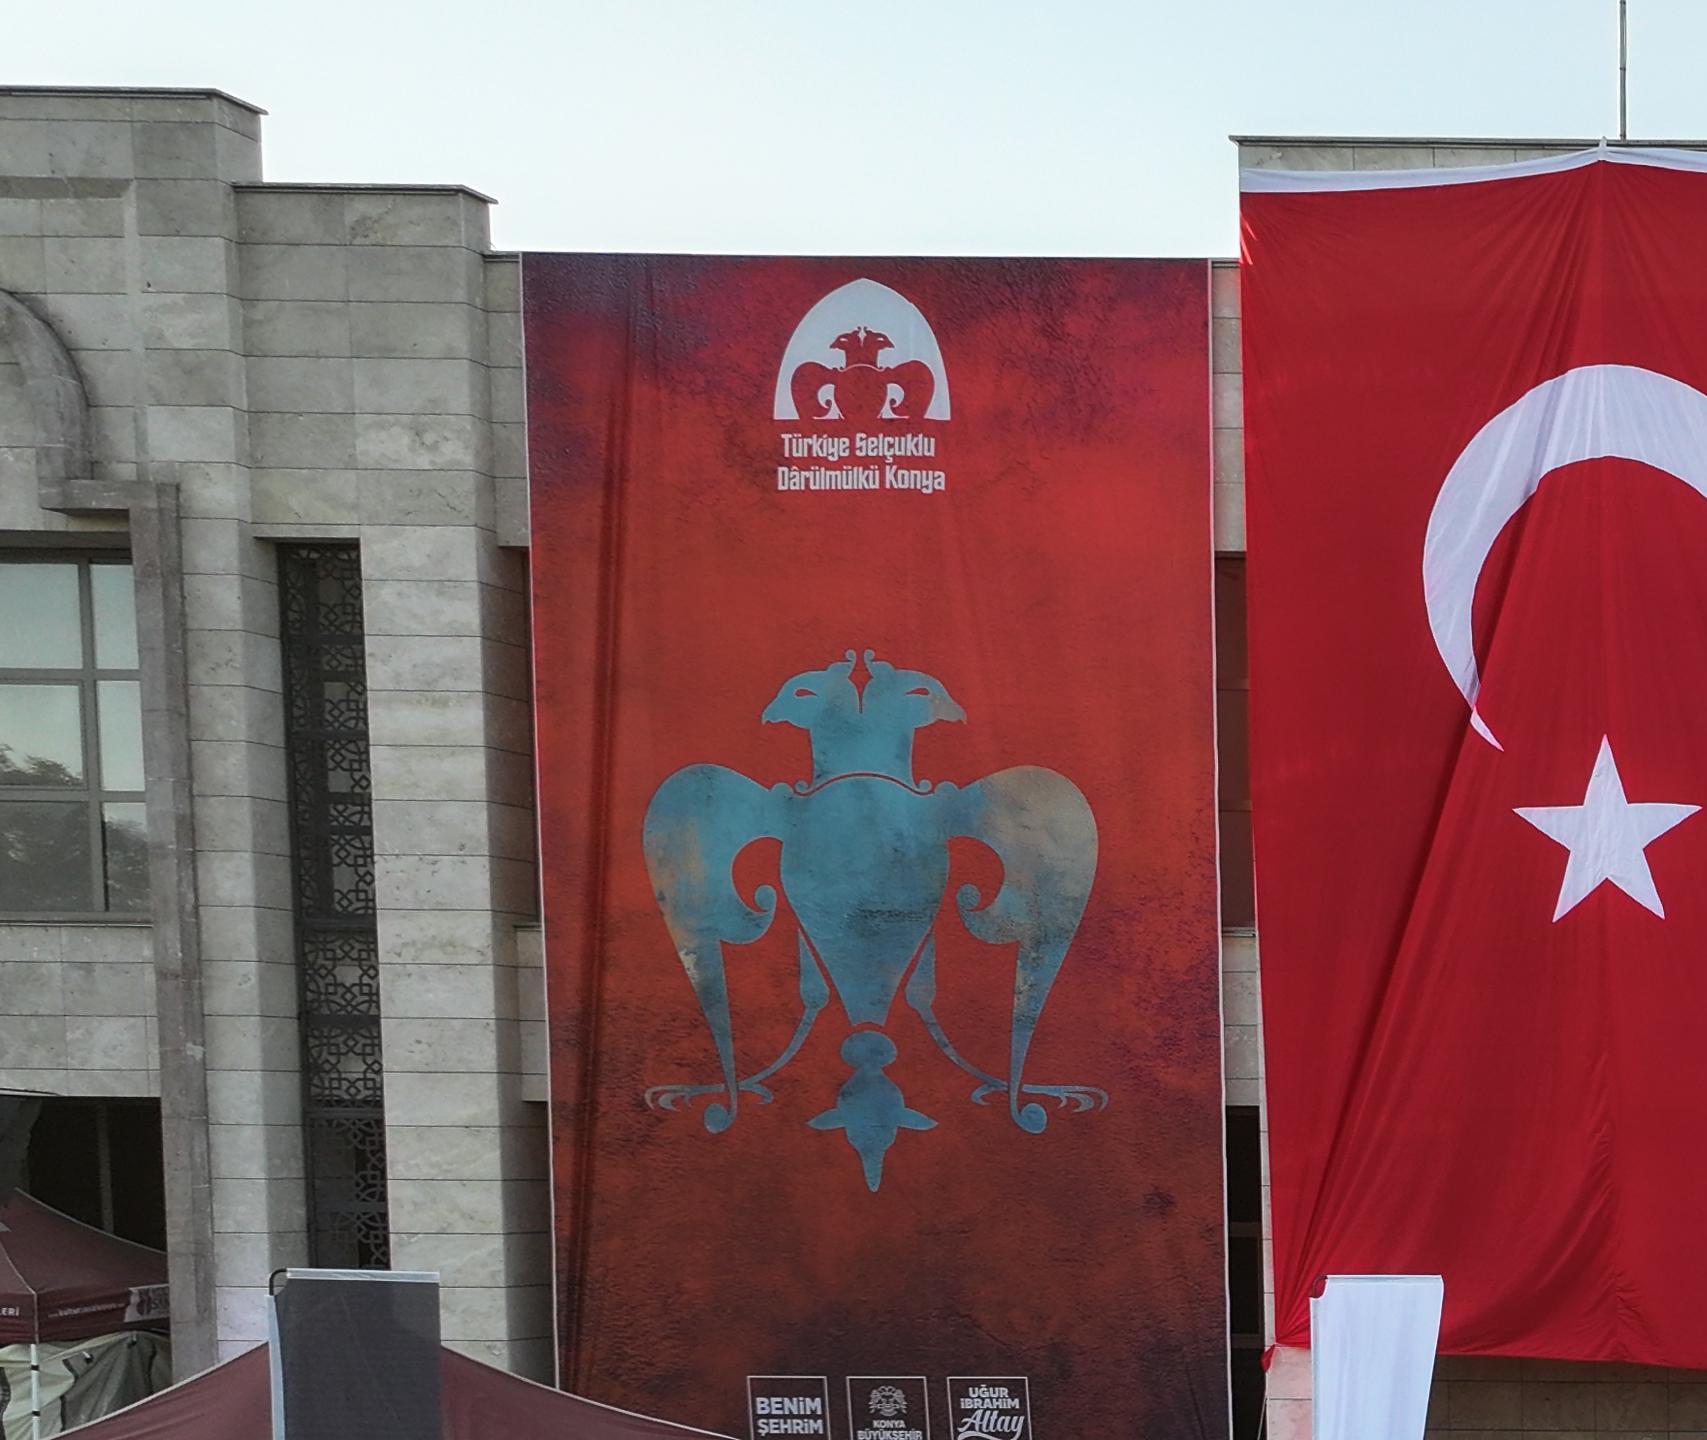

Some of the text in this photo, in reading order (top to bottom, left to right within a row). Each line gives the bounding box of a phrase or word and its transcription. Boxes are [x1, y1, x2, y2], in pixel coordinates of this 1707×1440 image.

[780, 432, 936, 463] Türkiye Selçuklu
[777, 465, 946, 494] Dârülmülkü Konya
[968, 1384, 1010, 1398] UĞUR
[872, 1419, 906, 1429] KONYA
[857, 1428, 923, 1440] BÜYÜKŞEHİR
